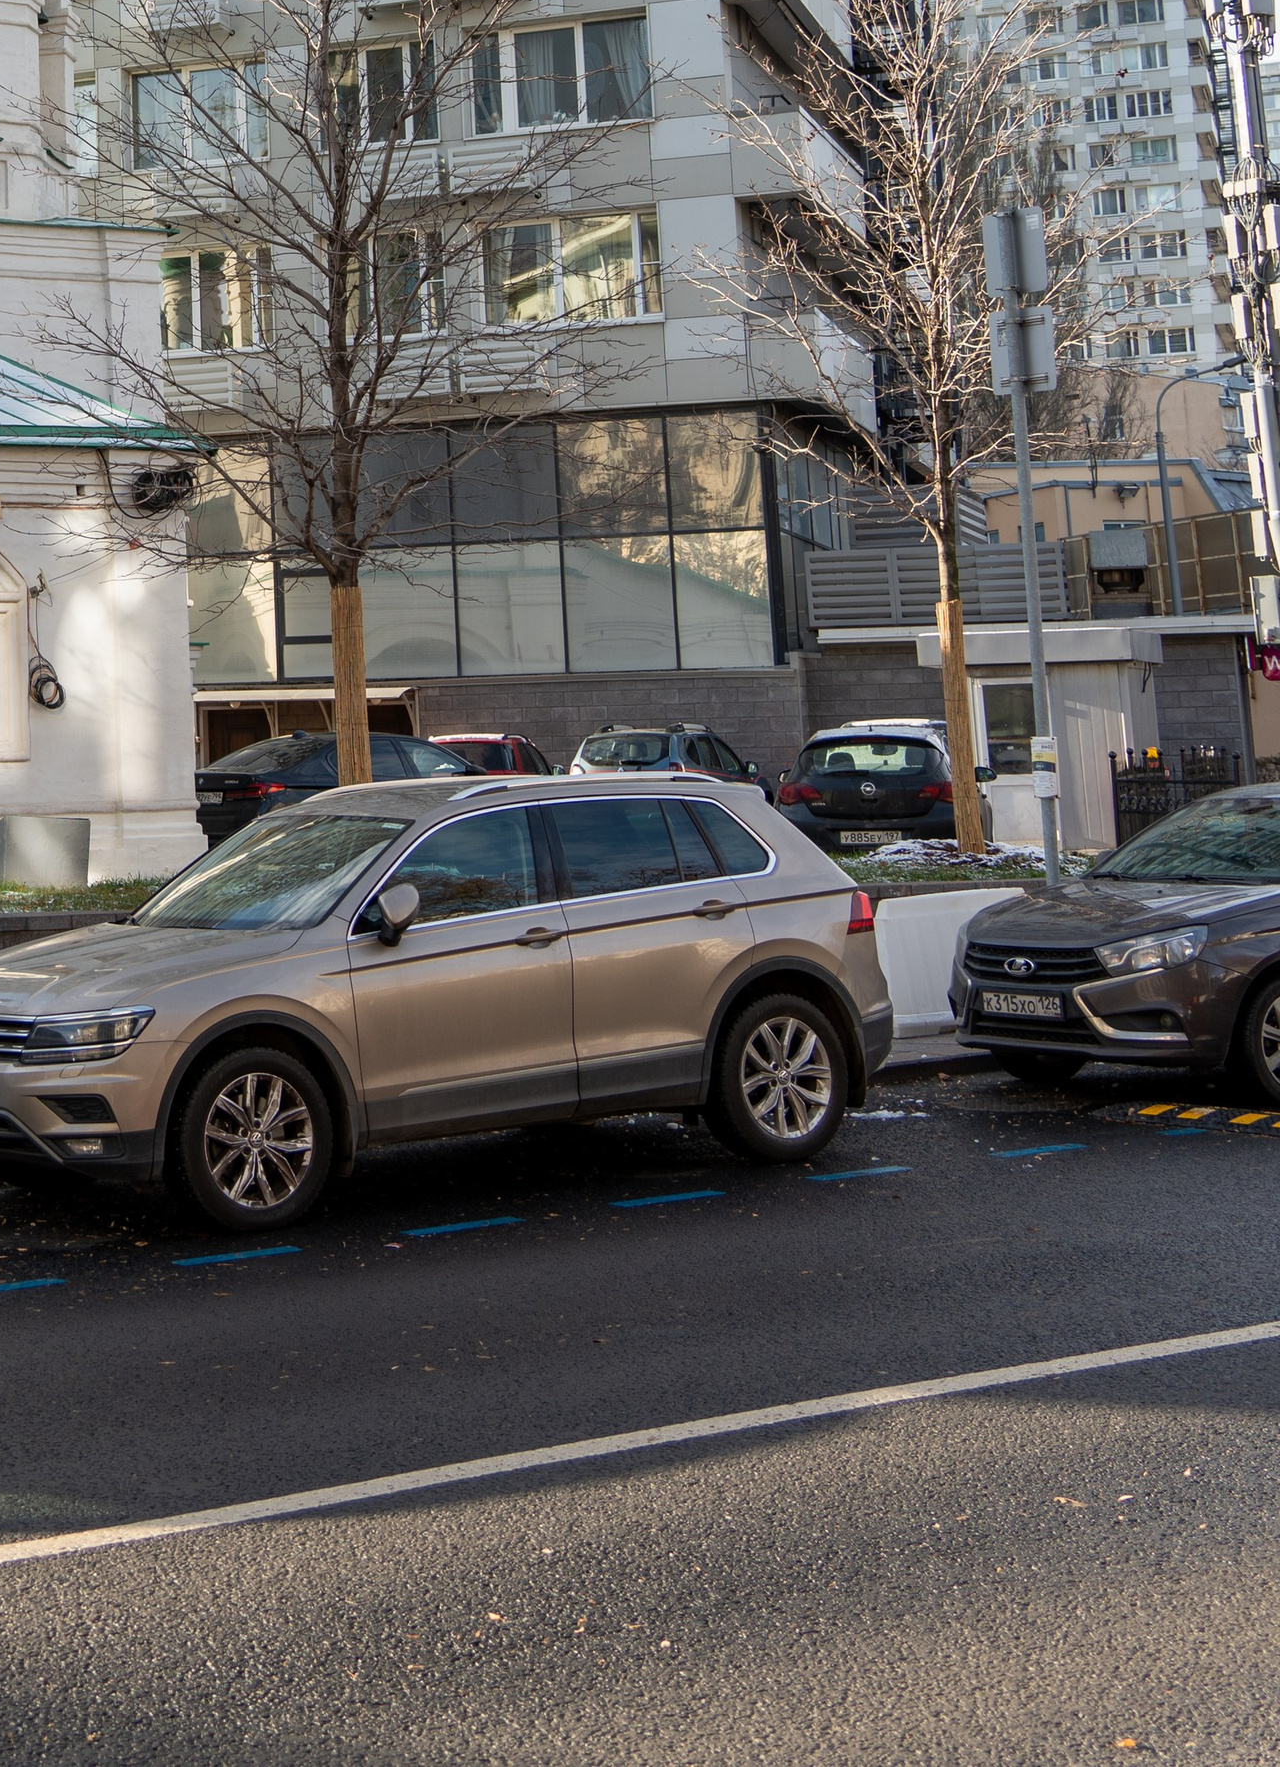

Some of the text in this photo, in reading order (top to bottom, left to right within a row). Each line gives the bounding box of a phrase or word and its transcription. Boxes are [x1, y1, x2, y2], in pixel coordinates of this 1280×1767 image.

[843, 831, 900, 843] У885ЕУ 197
[985, 994, 1059, 1014] К315ХО 126
